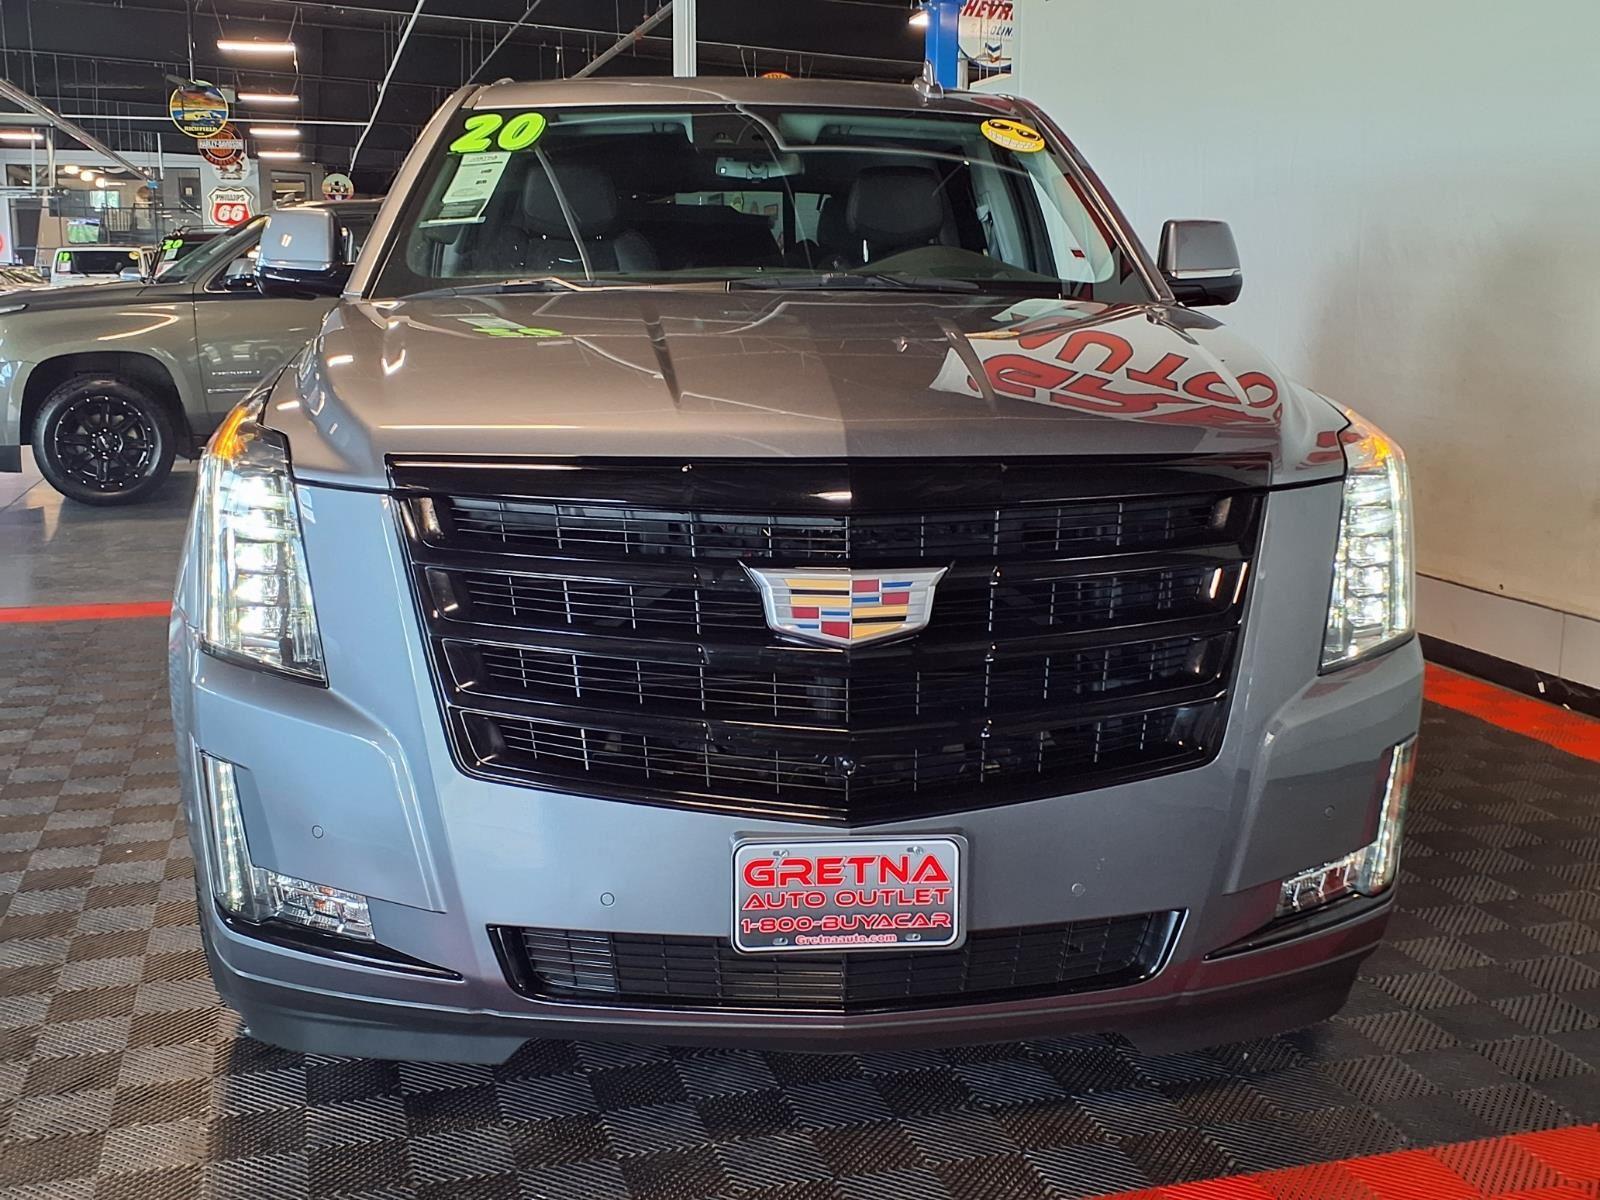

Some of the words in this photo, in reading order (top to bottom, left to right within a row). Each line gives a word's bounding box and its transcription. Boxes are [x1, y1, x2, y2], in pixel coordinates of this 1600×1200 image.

[962, 0, 1013, 20] HEVR
[449, 112, 546, 153] 20
[216, 193, 245, 202] PHILLIPS
[217, 204, 246, 222] 66
[163, 239, 184, 250] 20
[58, 251, 71, 262] 19
[743, 855, 951, 887] GRETNA
[742, 892, 827, 910] AUTO
[834, 887, 952, 907] OUTLET
[741, 912, 951, 933] 1-800-BUYACAR
[794, 933, 897, 945] Gretnaauto.com
